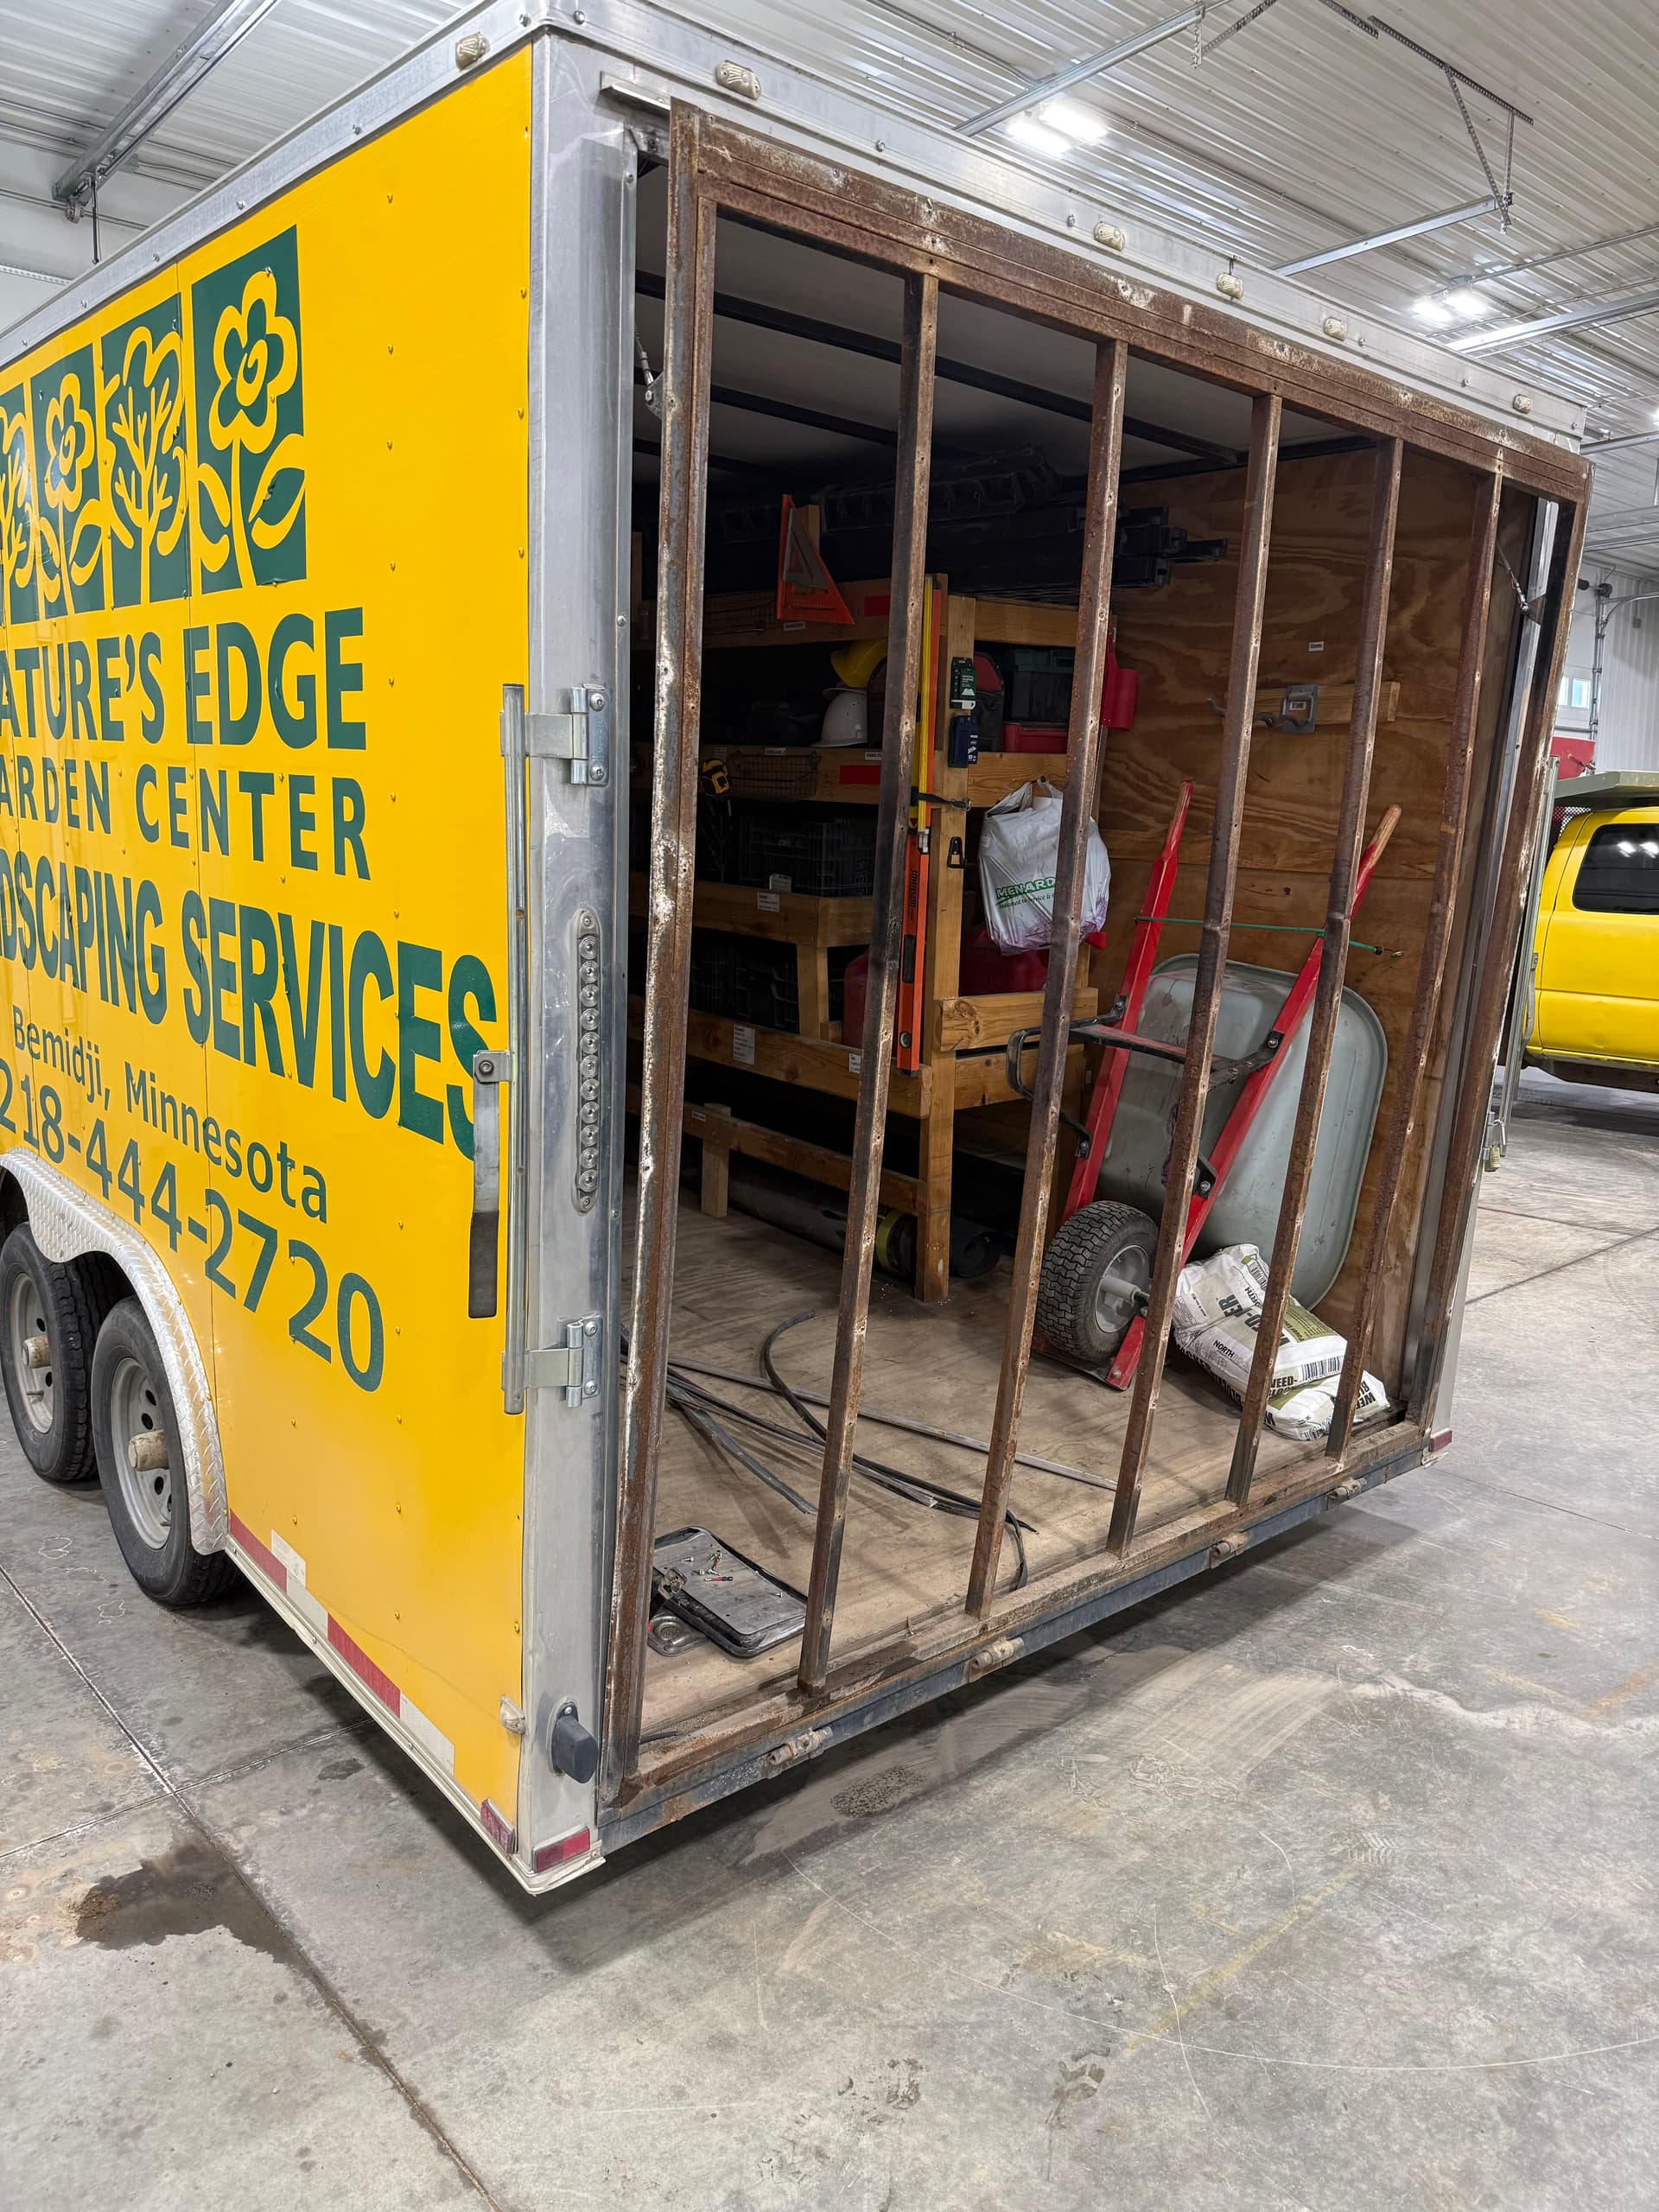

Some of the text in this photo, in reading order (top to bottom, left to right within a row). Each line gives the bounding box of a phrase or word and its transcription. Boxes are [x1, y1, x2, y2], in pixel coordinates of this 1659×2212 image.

[183, 607, 366, 750] EDGE
[136, 764, 371, 880] CENTER
[995, 877, 1056, 899] MENARD
[0, 849, 497, 1161] DSCAPING SERVICES
[13, 1005, 327, 1224] Bemidji, Minnesota
[0, 1058, 384, 1392] 218-444-2720
